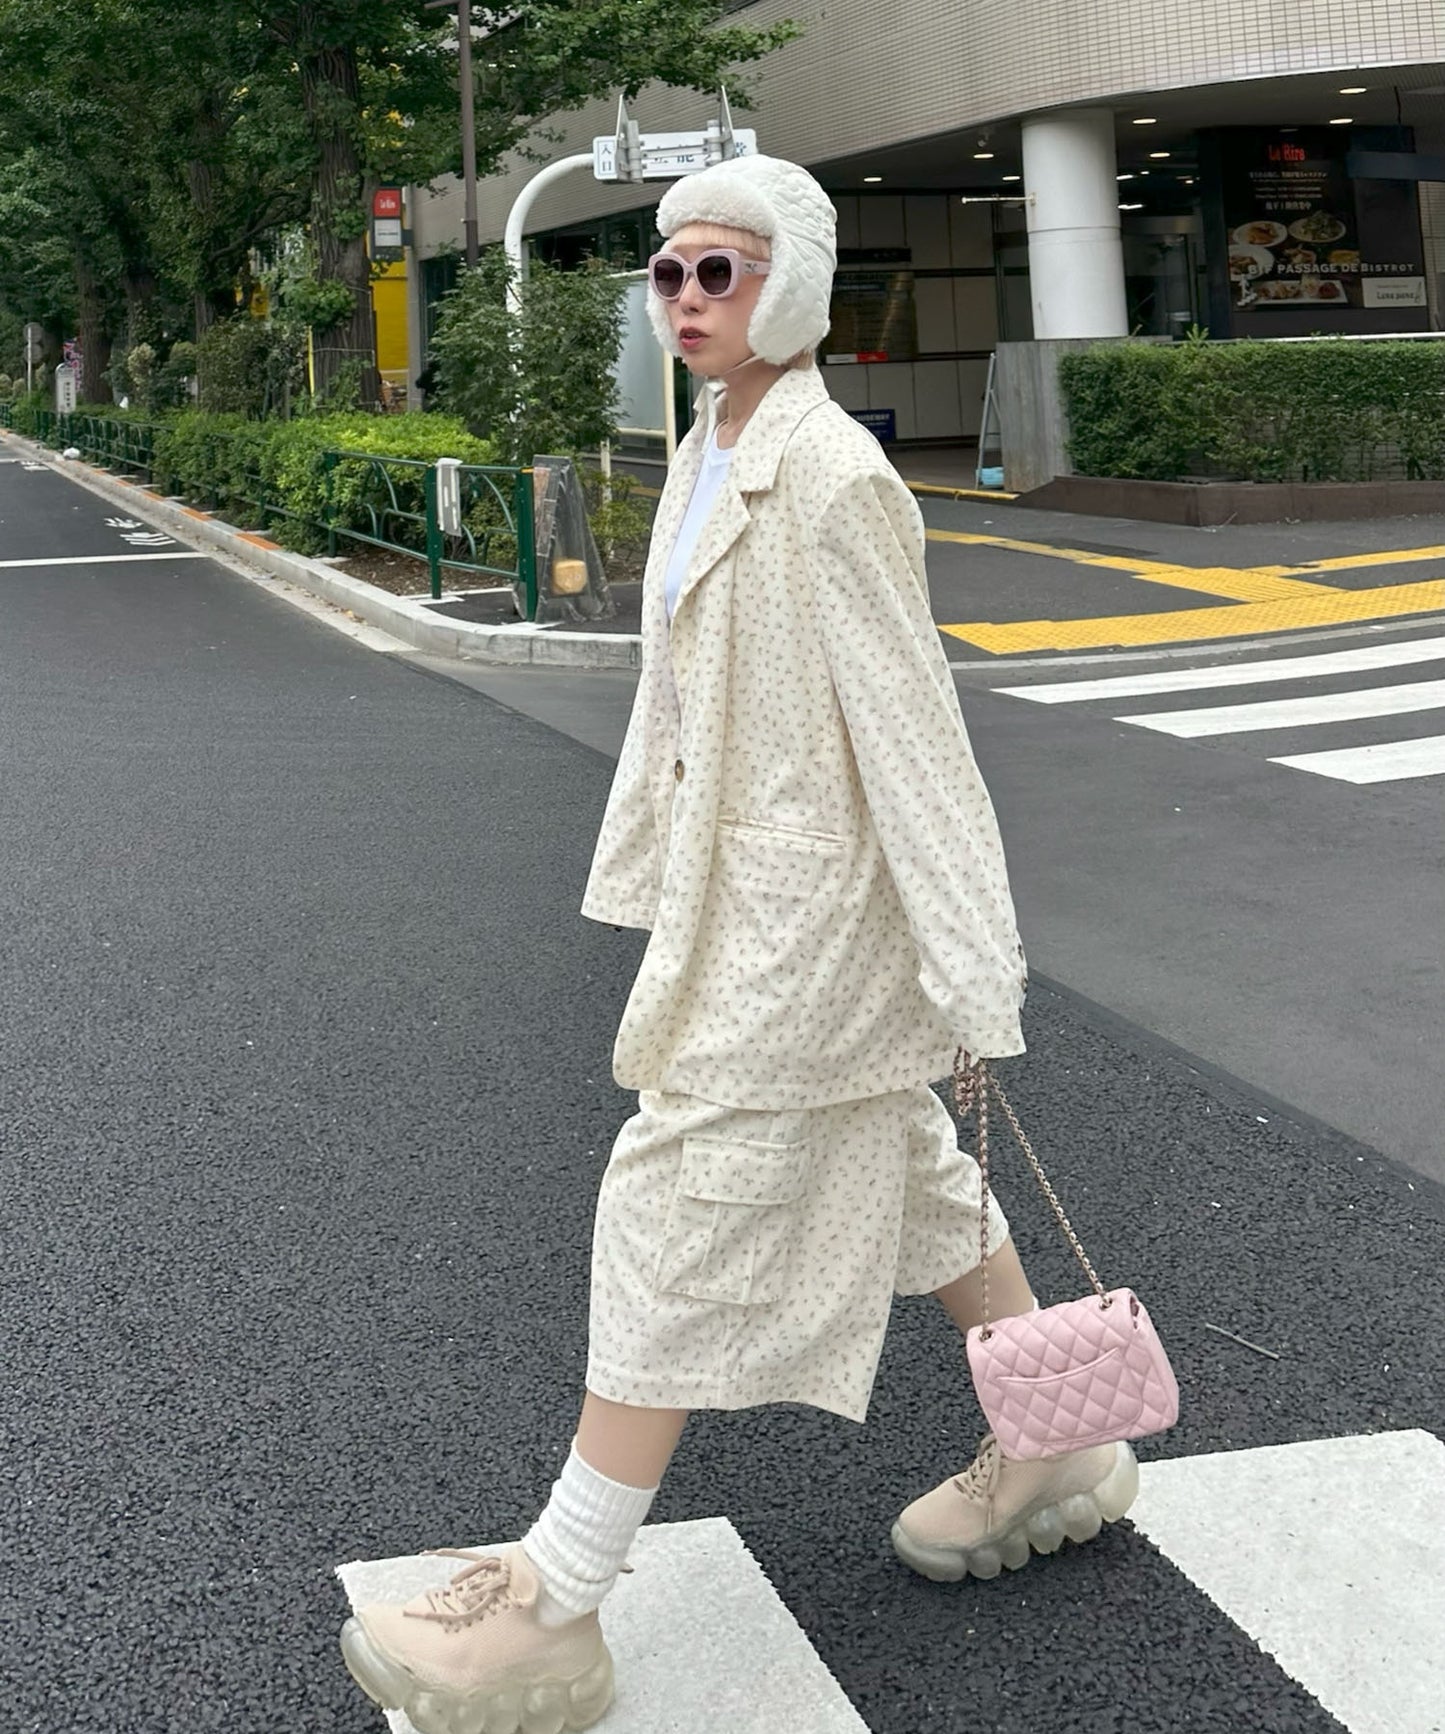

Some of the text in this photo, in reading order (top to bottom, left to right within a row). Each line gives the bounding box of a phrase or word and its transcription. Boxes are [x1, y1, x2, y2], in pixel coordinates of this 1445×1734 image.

[1277, 263, 1338, 274] PASSAGE
[1341, 263, 1359, 273] DE
[1360, 262, 1415, 273] BISTROT
